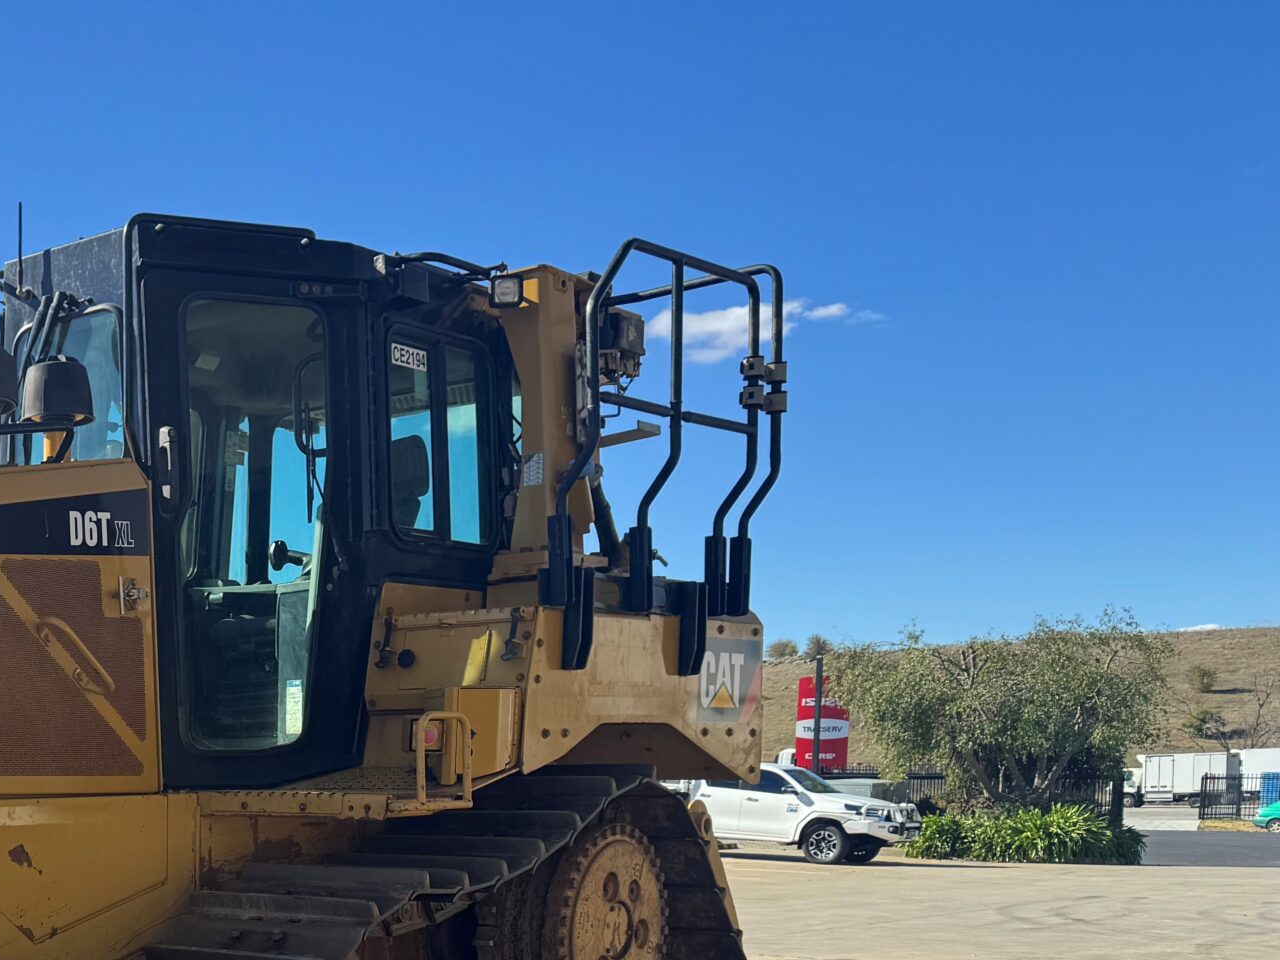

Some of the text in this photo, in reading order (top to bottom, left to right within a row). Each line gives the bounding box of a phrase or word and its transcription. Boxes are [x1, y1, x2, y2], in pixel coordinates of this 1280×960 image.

[393, 346, 426, 369] CE2194
[69, 510, 135, 547] D6T XL
[701, 651, 744, 708] CAT
